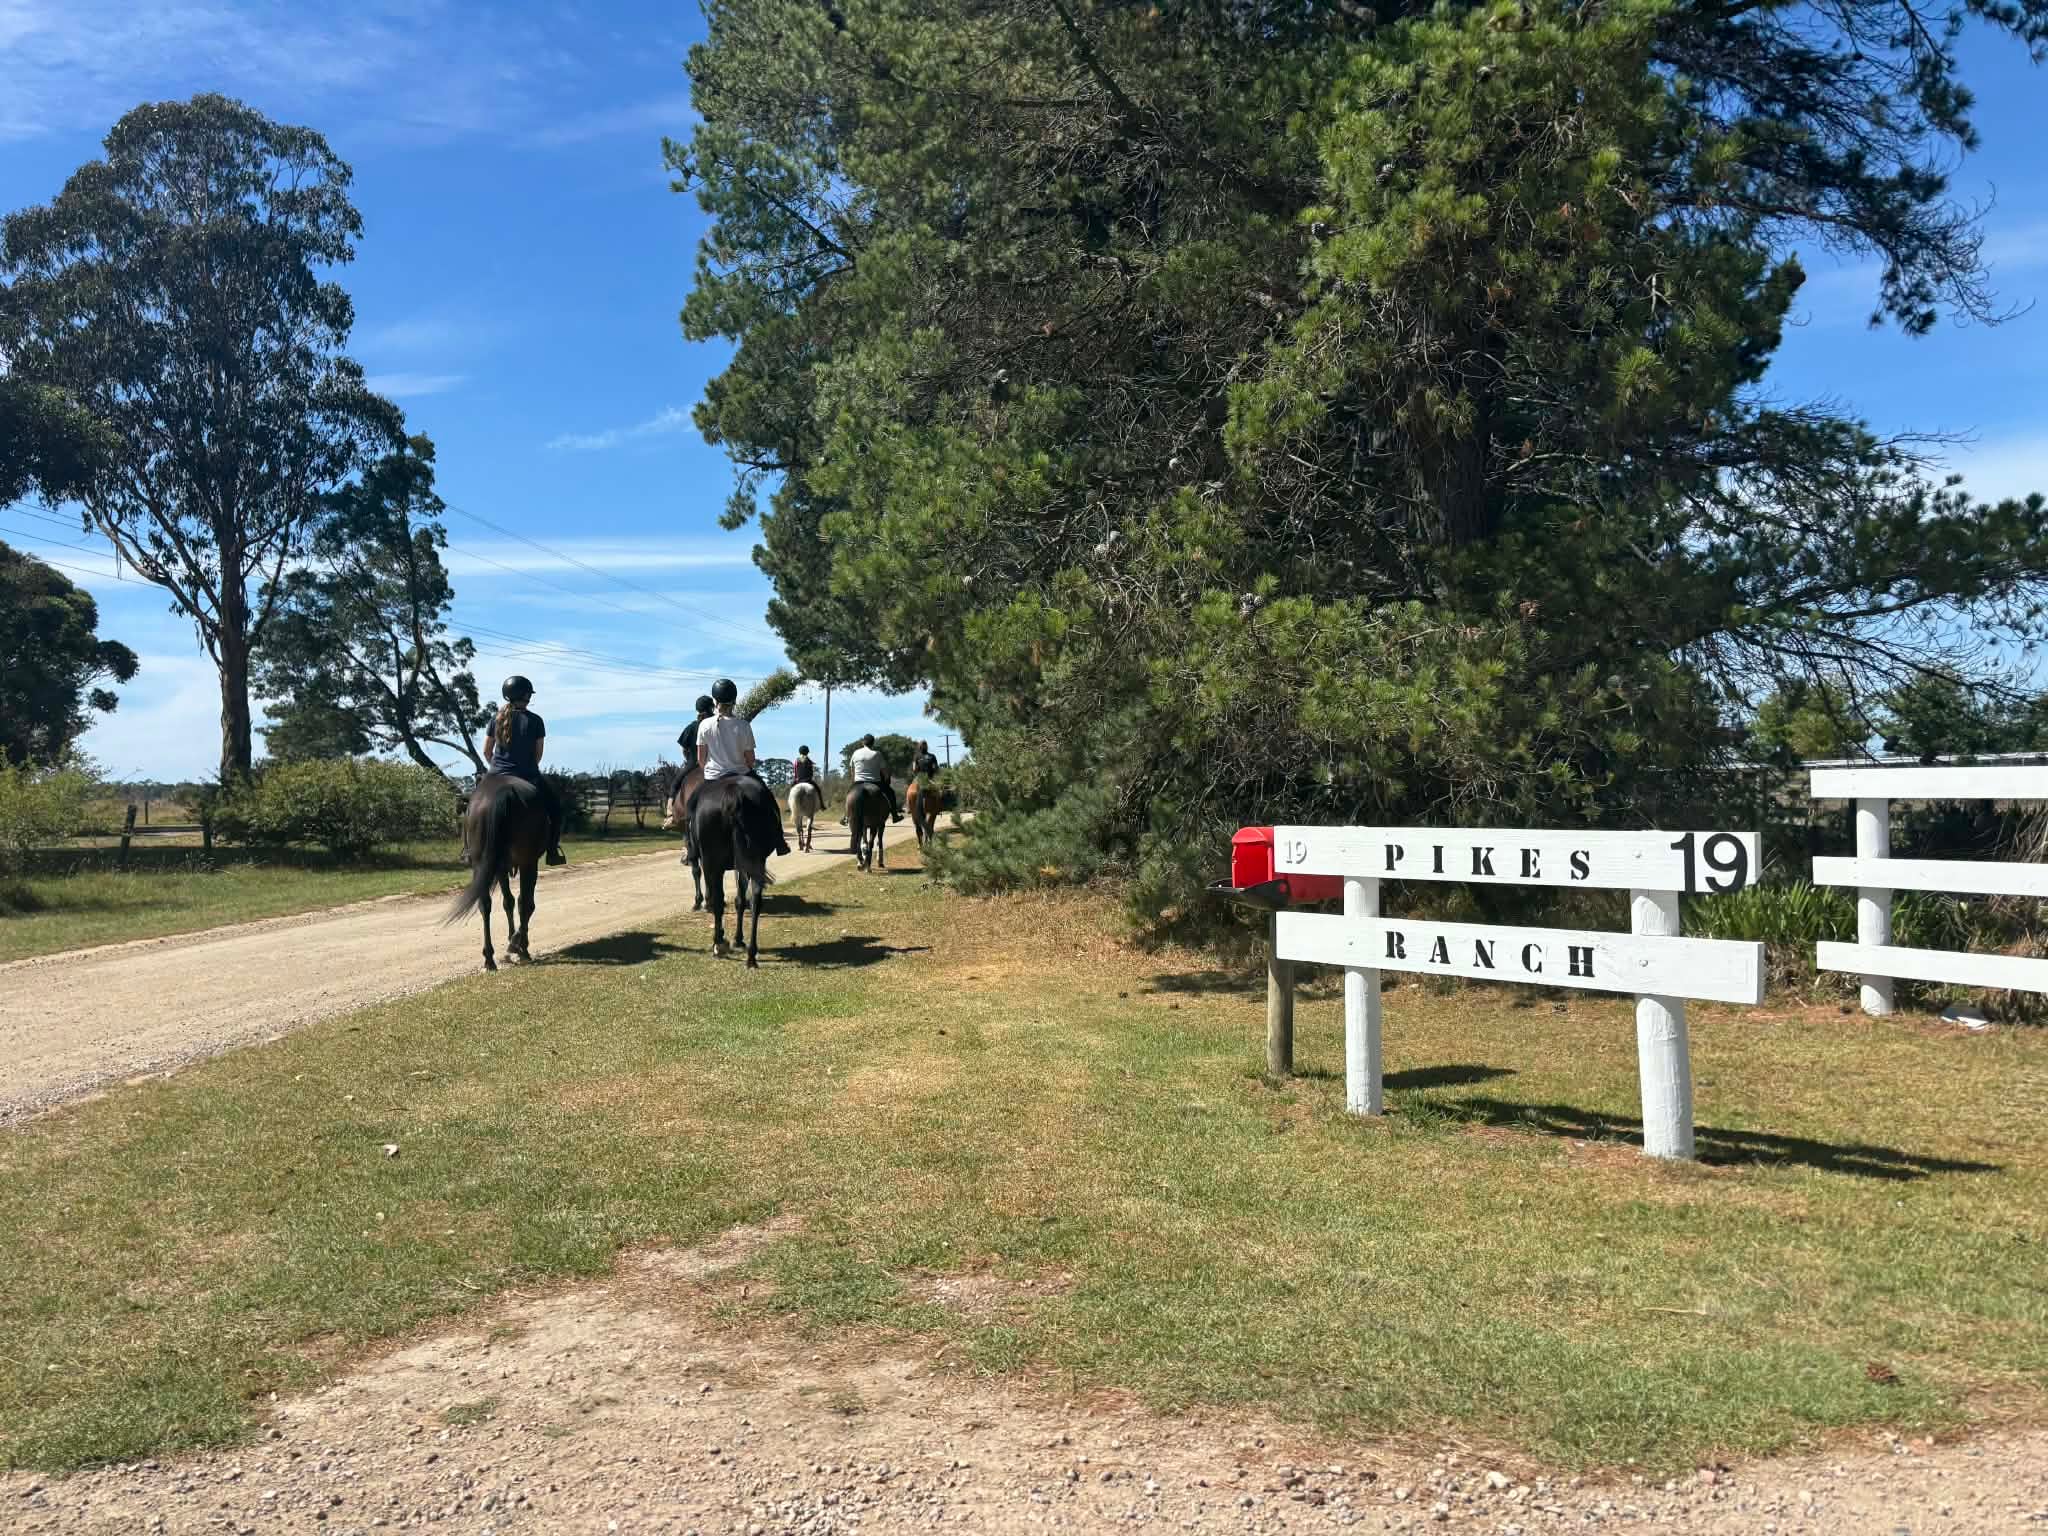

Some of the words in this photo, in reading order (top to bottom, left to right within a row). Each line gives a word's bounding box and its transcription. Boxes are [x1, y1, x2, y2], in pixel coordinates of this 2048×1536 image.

[1284, 840, 1308, 865] 19
[1384, 844, 1590, 880] PIKES
[1670, 832, 1748, 894] 19
[1386, 931, 1595, 978] RANCH
